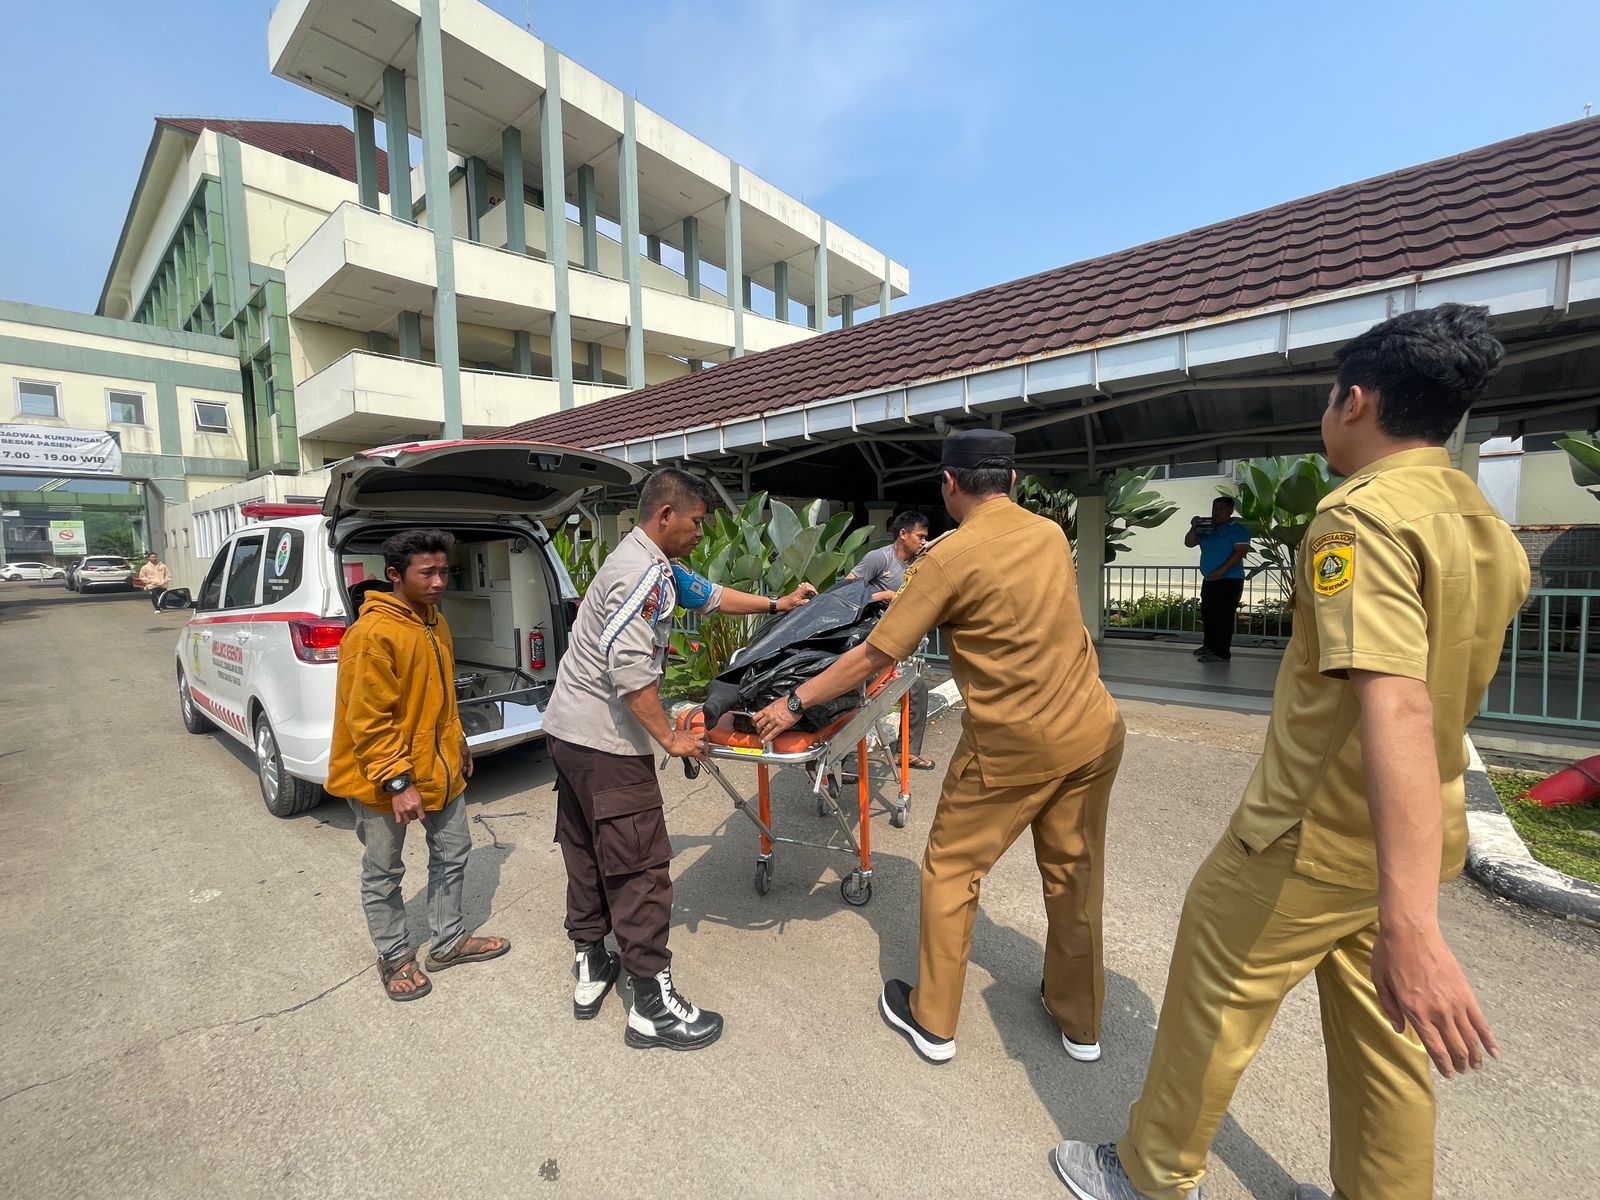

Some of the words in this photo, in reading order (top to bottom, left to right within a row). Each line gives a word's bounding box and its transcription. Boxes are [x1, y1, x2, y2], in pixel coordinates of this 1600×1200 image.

[0, 431, 42, 439] JADWAL
[44, 434, 102, 443] KUNJUNGAN
[44, 453, 77, 462] 19.00
[80, 455, 106, 464] WIB
